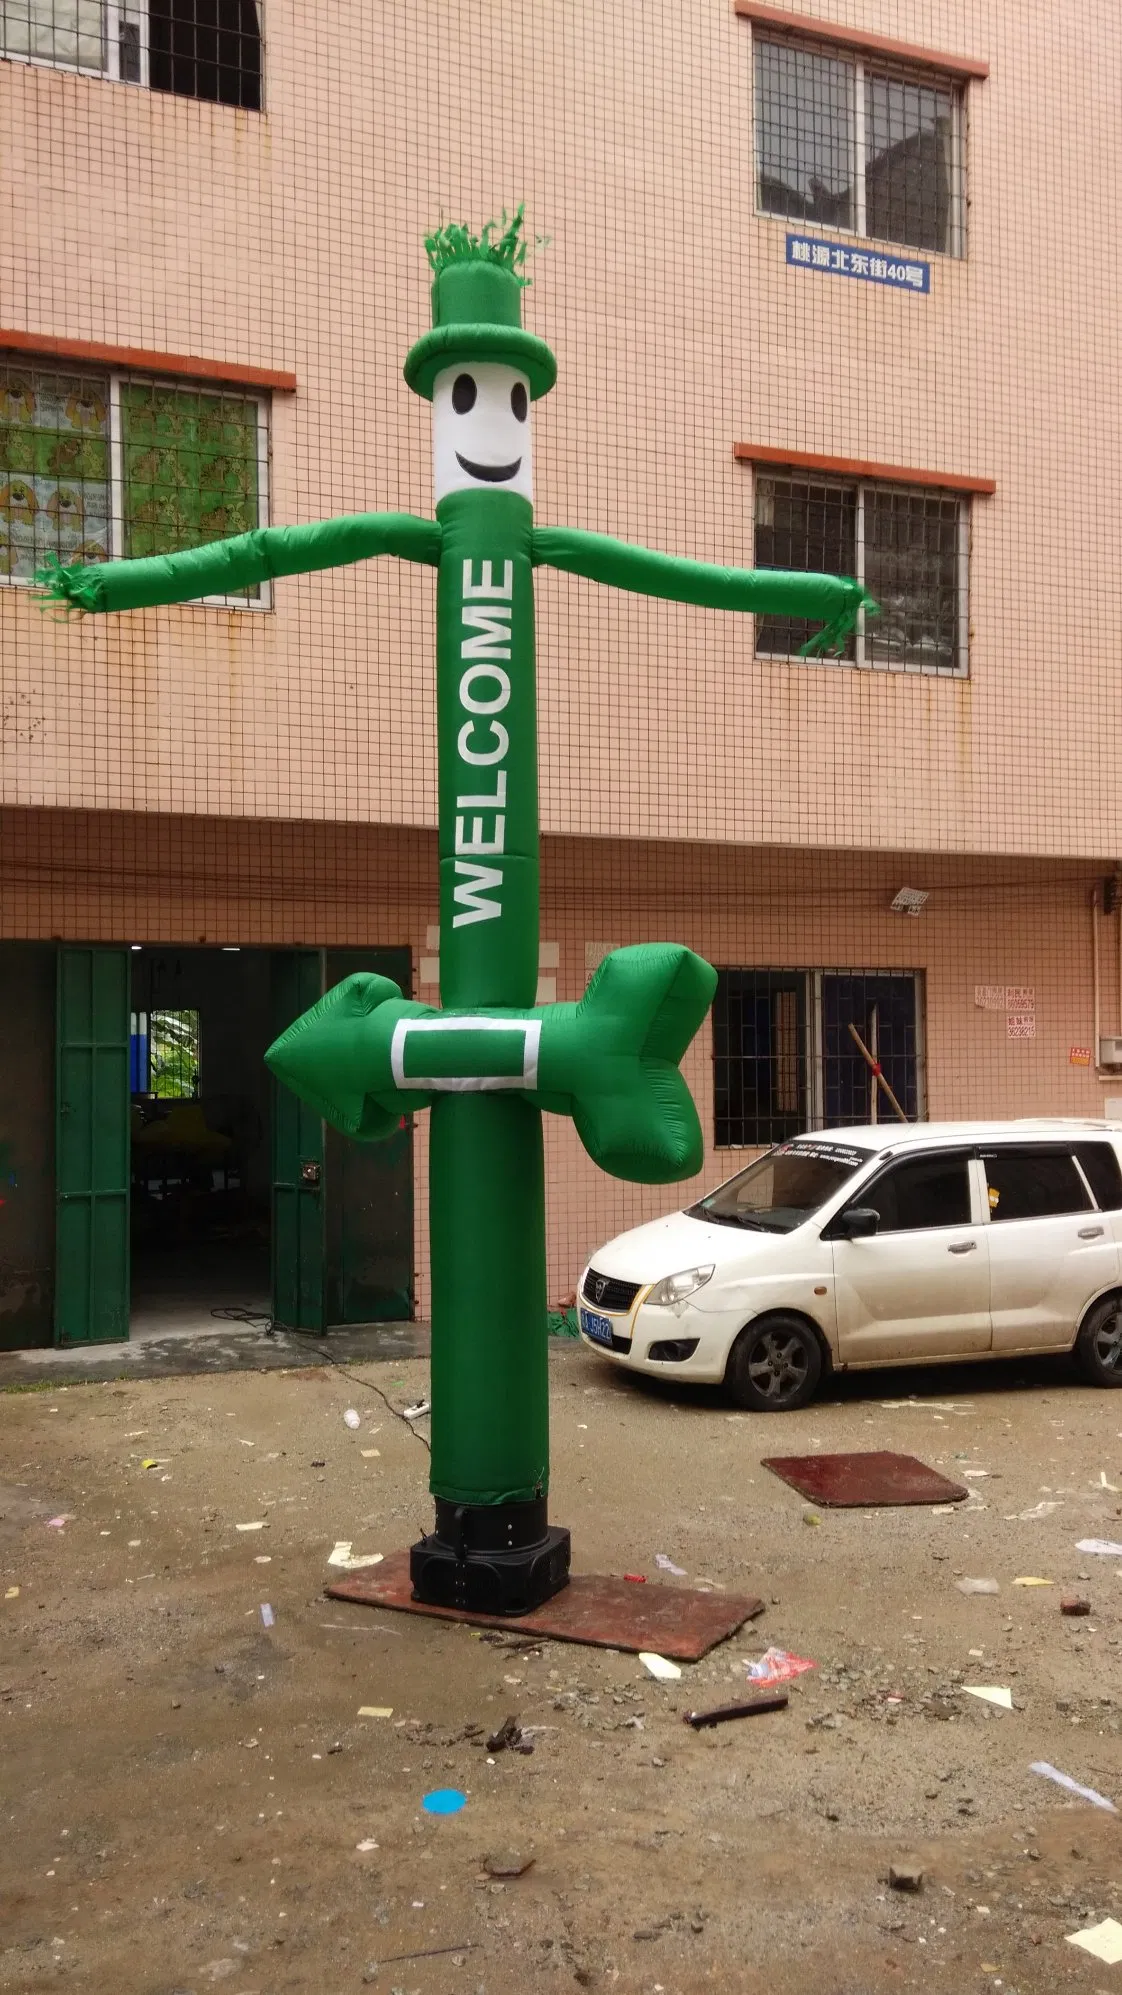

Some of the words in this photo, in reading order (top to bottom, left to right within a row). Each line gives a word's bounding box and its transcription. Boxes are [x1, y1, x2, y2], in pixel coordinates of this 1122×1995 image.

[791, 240, 923, 288] 桃源北东街40号
[453, 558, 513, 929] WELCOME
